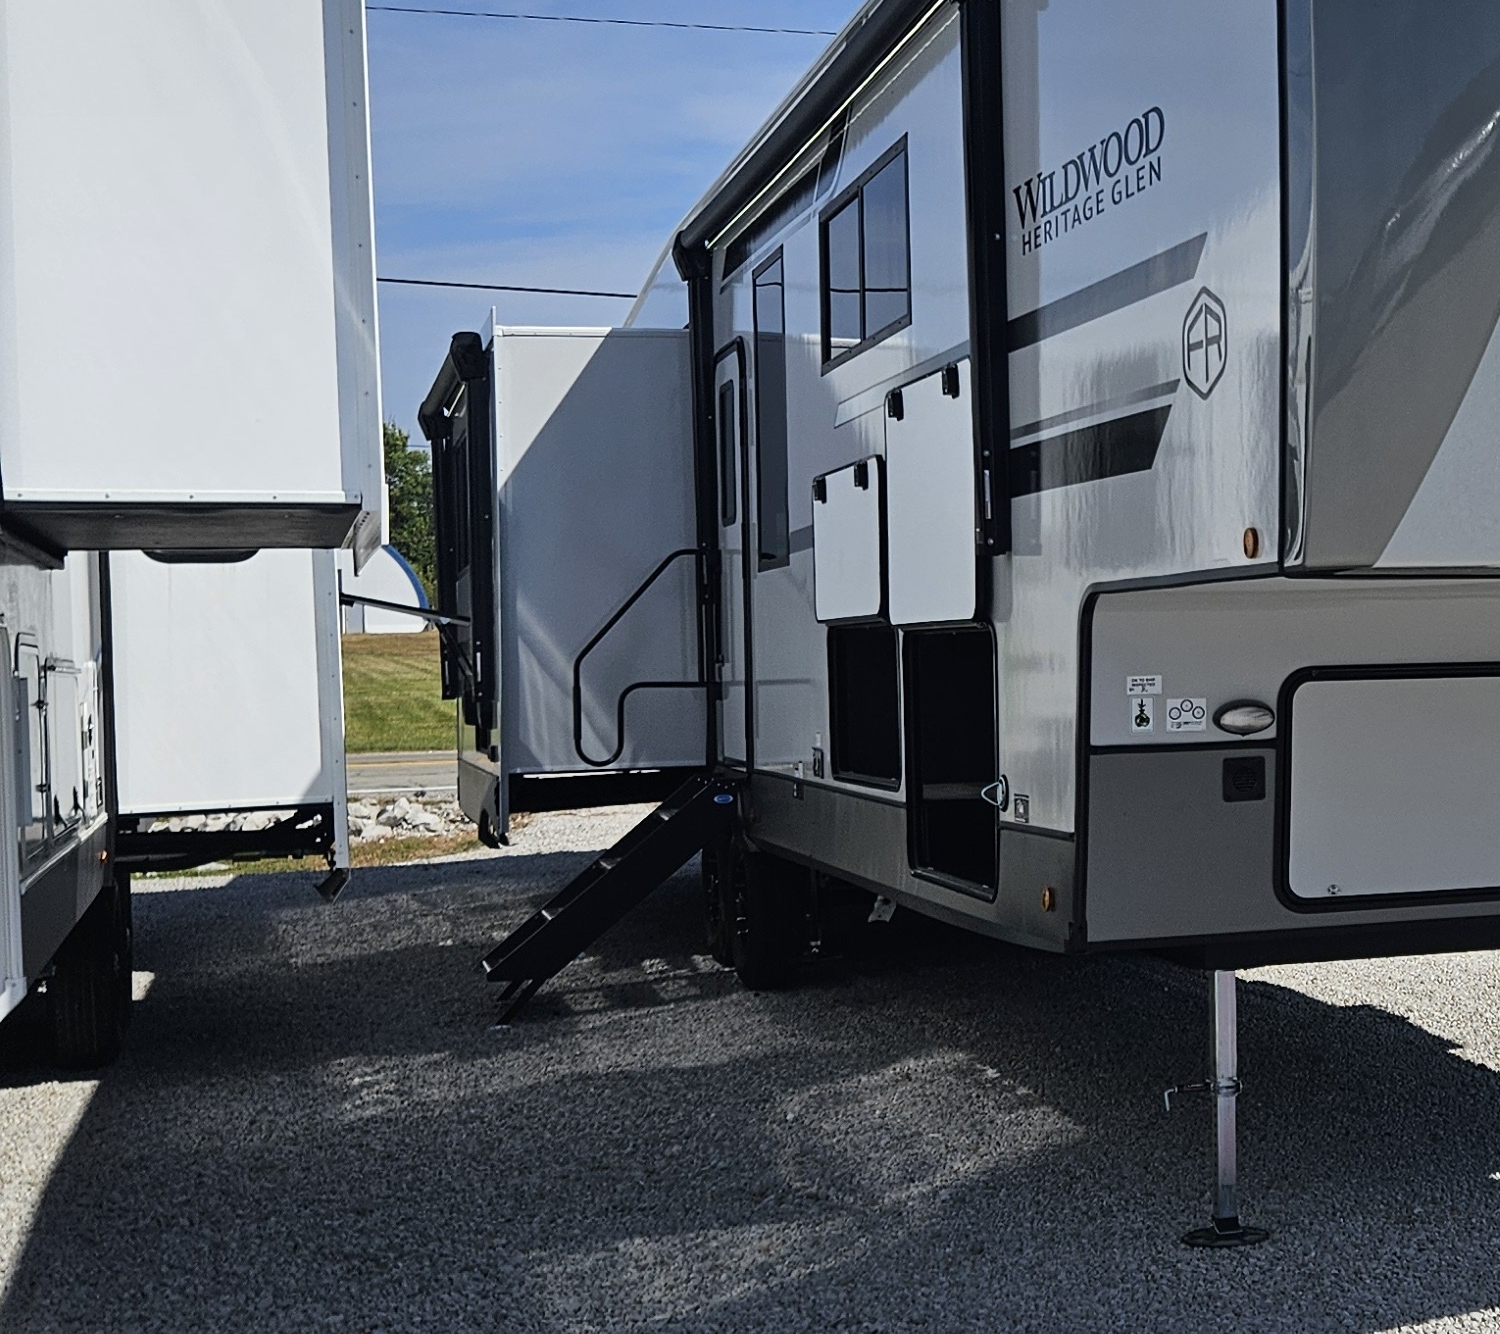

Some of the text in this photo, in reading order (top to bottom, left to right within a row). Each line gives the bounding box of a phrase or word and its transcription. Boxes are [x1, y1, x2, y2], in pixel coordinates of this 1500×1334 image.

[1012, 105, 1166, 229] WILDWOOD
[1021, 155, 1164, 257] HERITAGE GLEN
